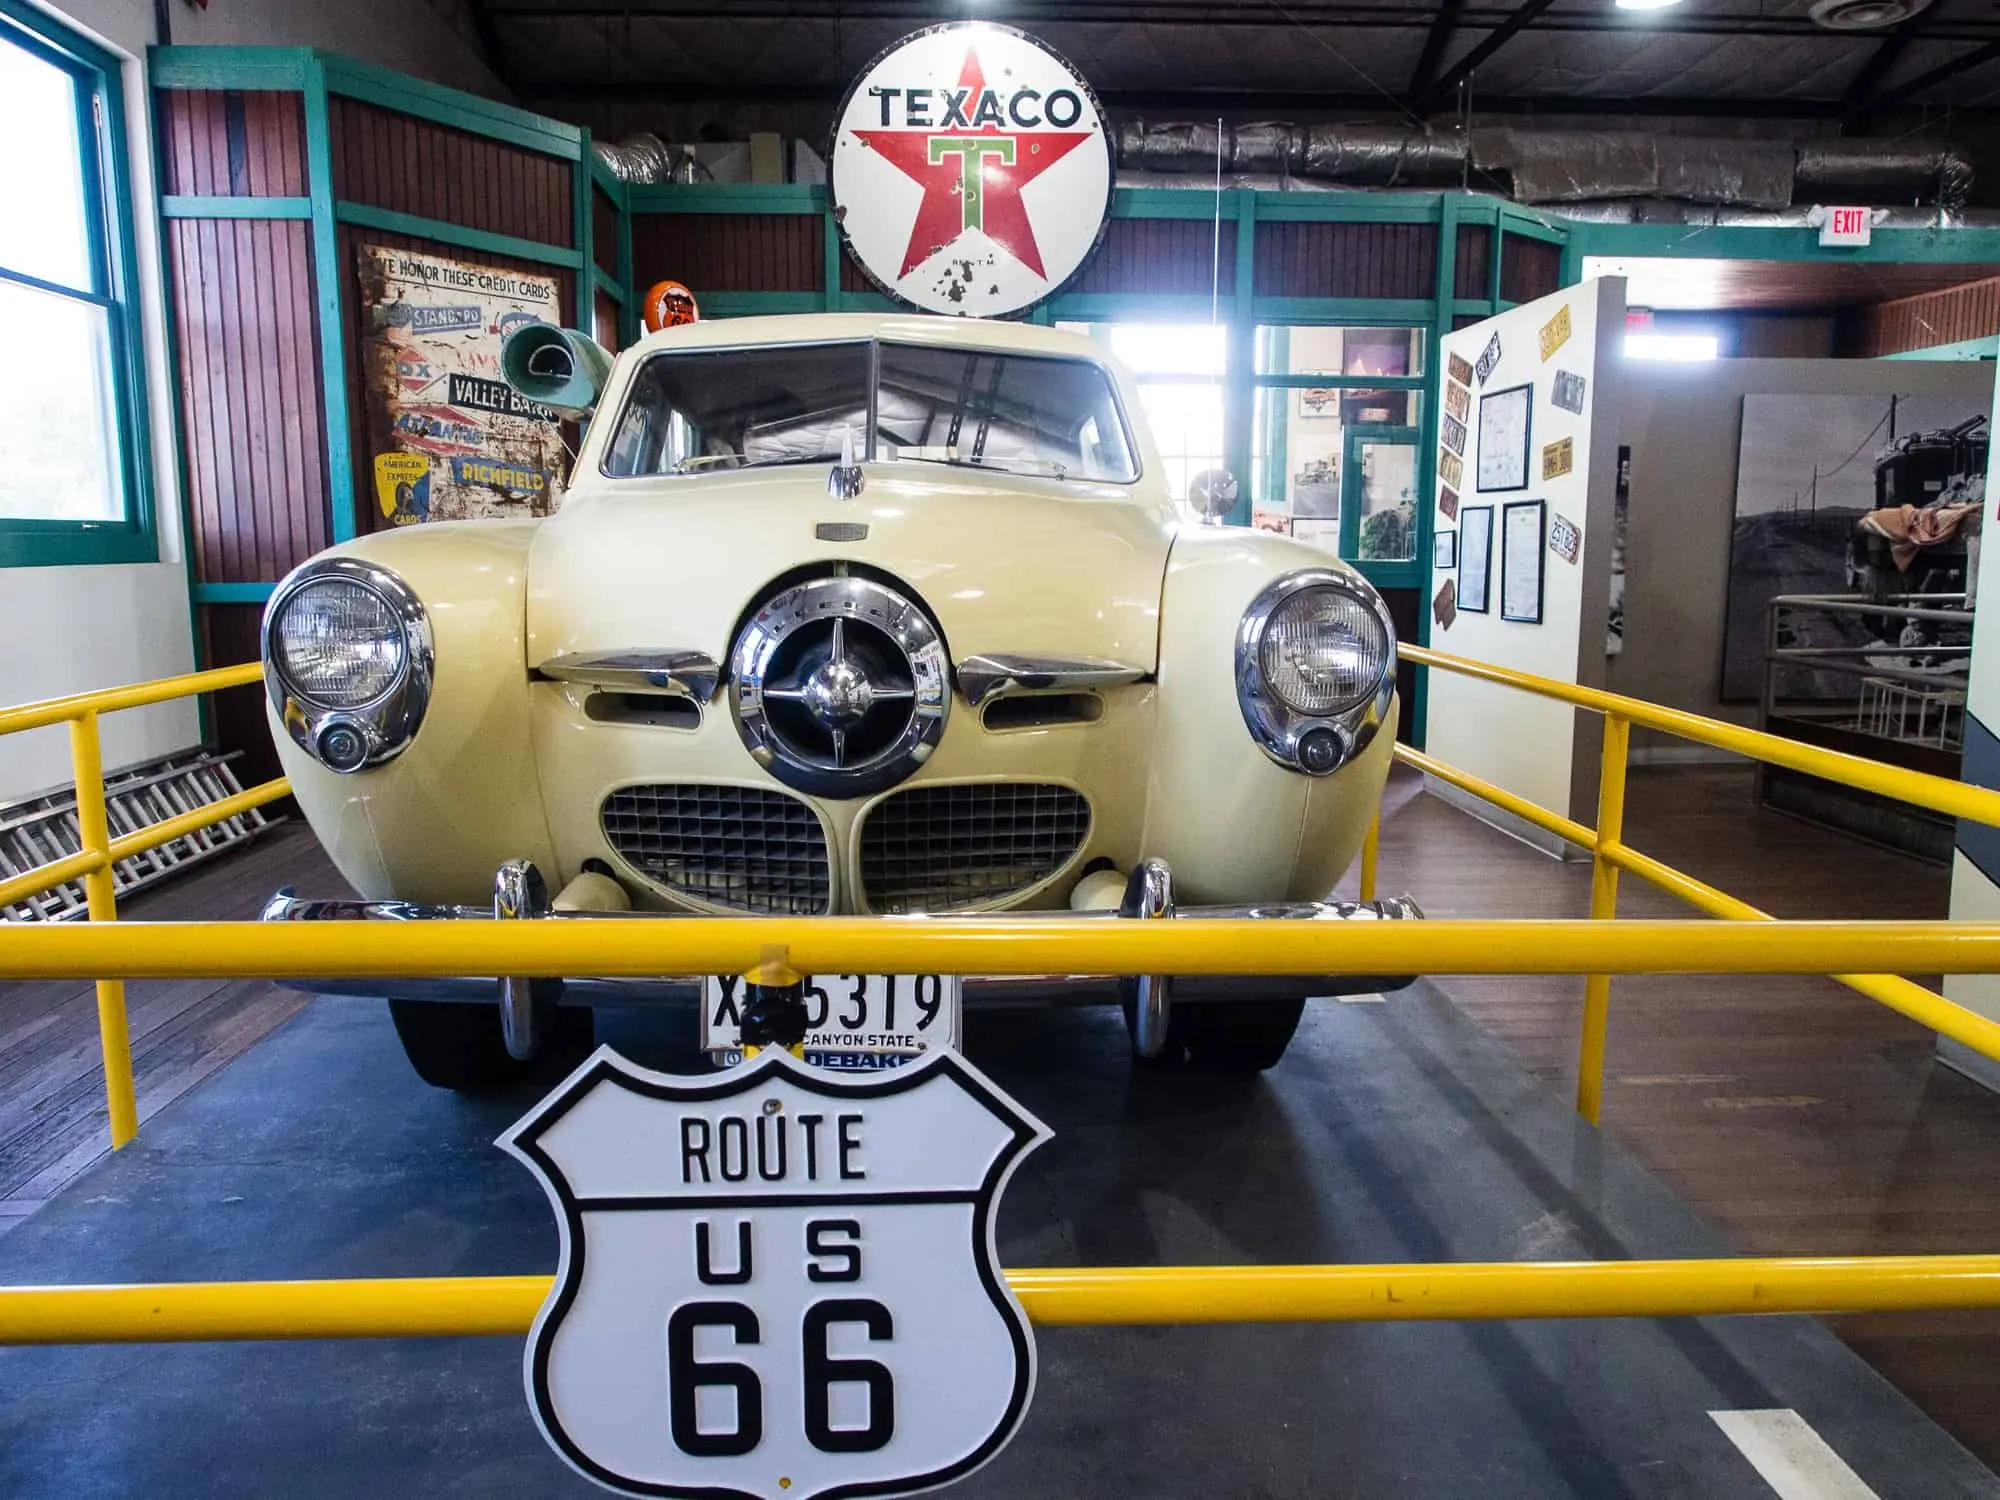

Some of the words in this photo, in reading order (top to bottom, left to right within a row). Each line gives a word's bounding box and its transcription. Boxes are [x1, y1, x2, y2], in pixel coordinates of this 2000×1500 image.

[869, 87, 1082, 128] TEXACO
[1834, 210, 1863, 234] EXIT
[400, 261, 439, 281] HONOR
[442, 268, 476, 288] THESE
[478, 274, 516, 295] CREDIT
[519, 281, 550, 300] CARDS
[455, 379, 508, 412] VALLEY
[384, 460, 422, 469] AMERICAN
[462, 463, 544, 491] RICHFIELD
[867, 1035, 914, 1047] STATE
[680, 1114, 865, 1182] ROUTE
[668, 1299, 895, 1456] 66
